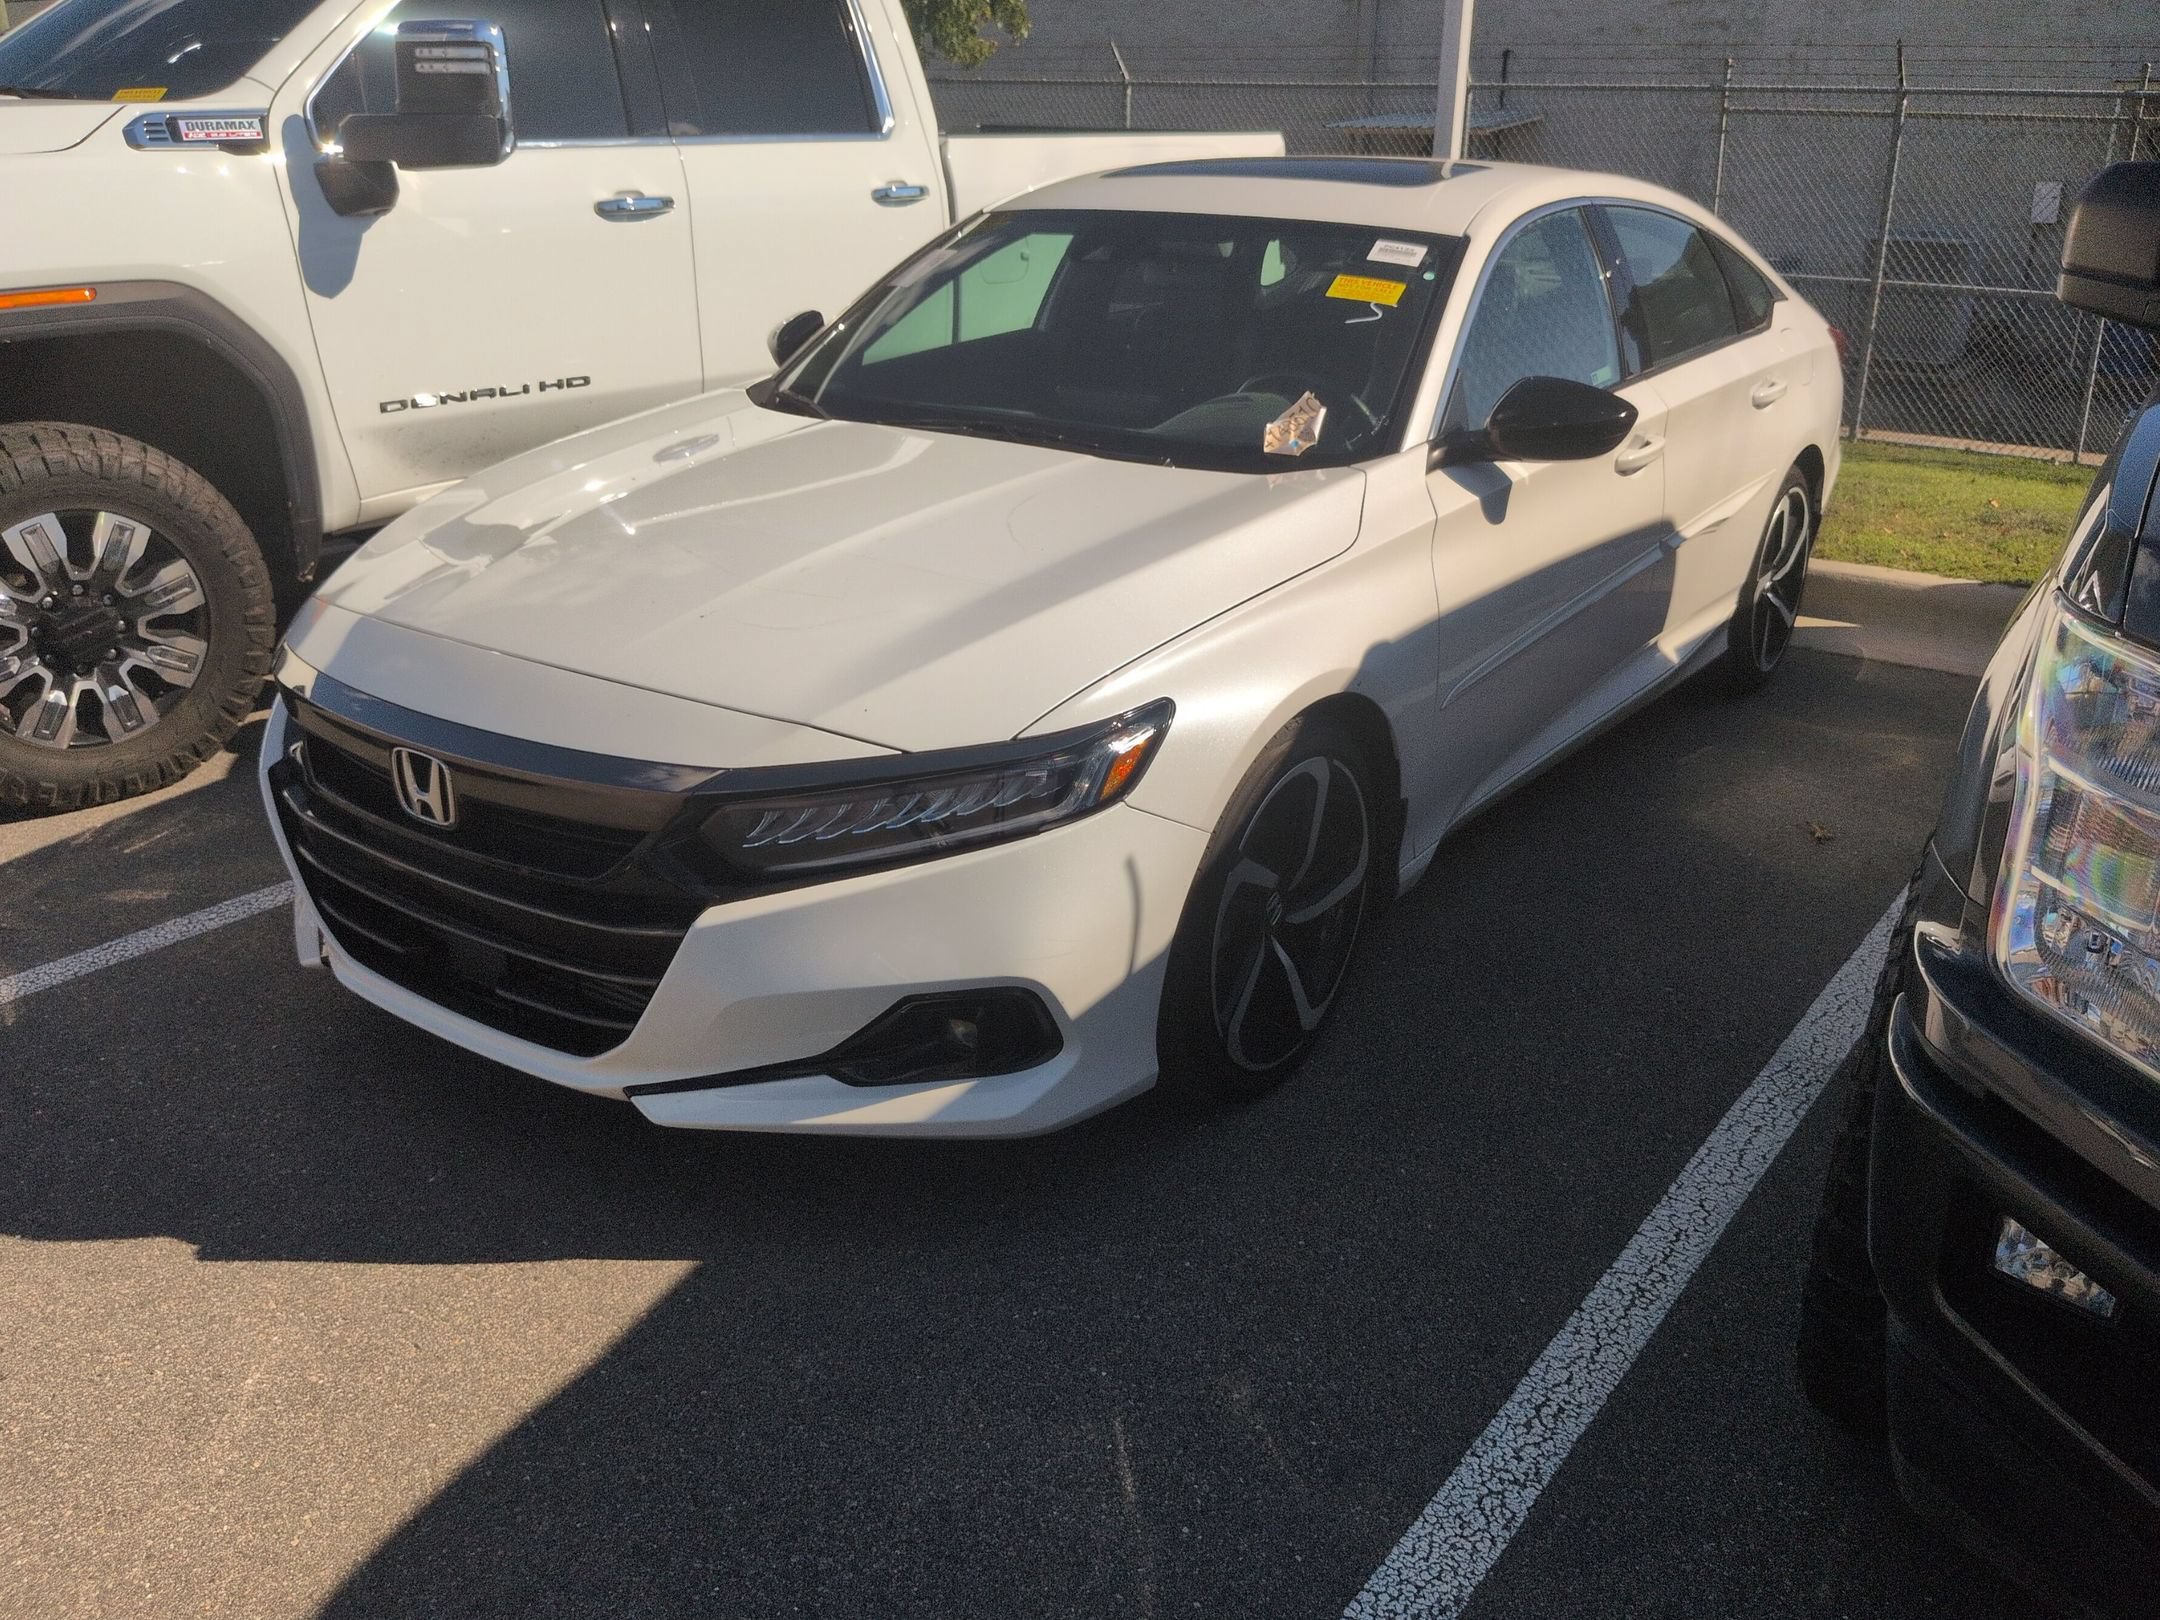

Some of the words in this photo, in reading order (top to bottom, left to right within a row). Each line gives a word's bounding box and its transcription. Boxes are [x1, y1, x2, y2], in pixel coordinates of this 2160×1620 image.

[185, 121, 256, 132] DURAMAX
[1362, 279, 1400, 290] VEHICLE
[380, 382, 530, 414] DENALI
[539, 375, 591, 392] HD
